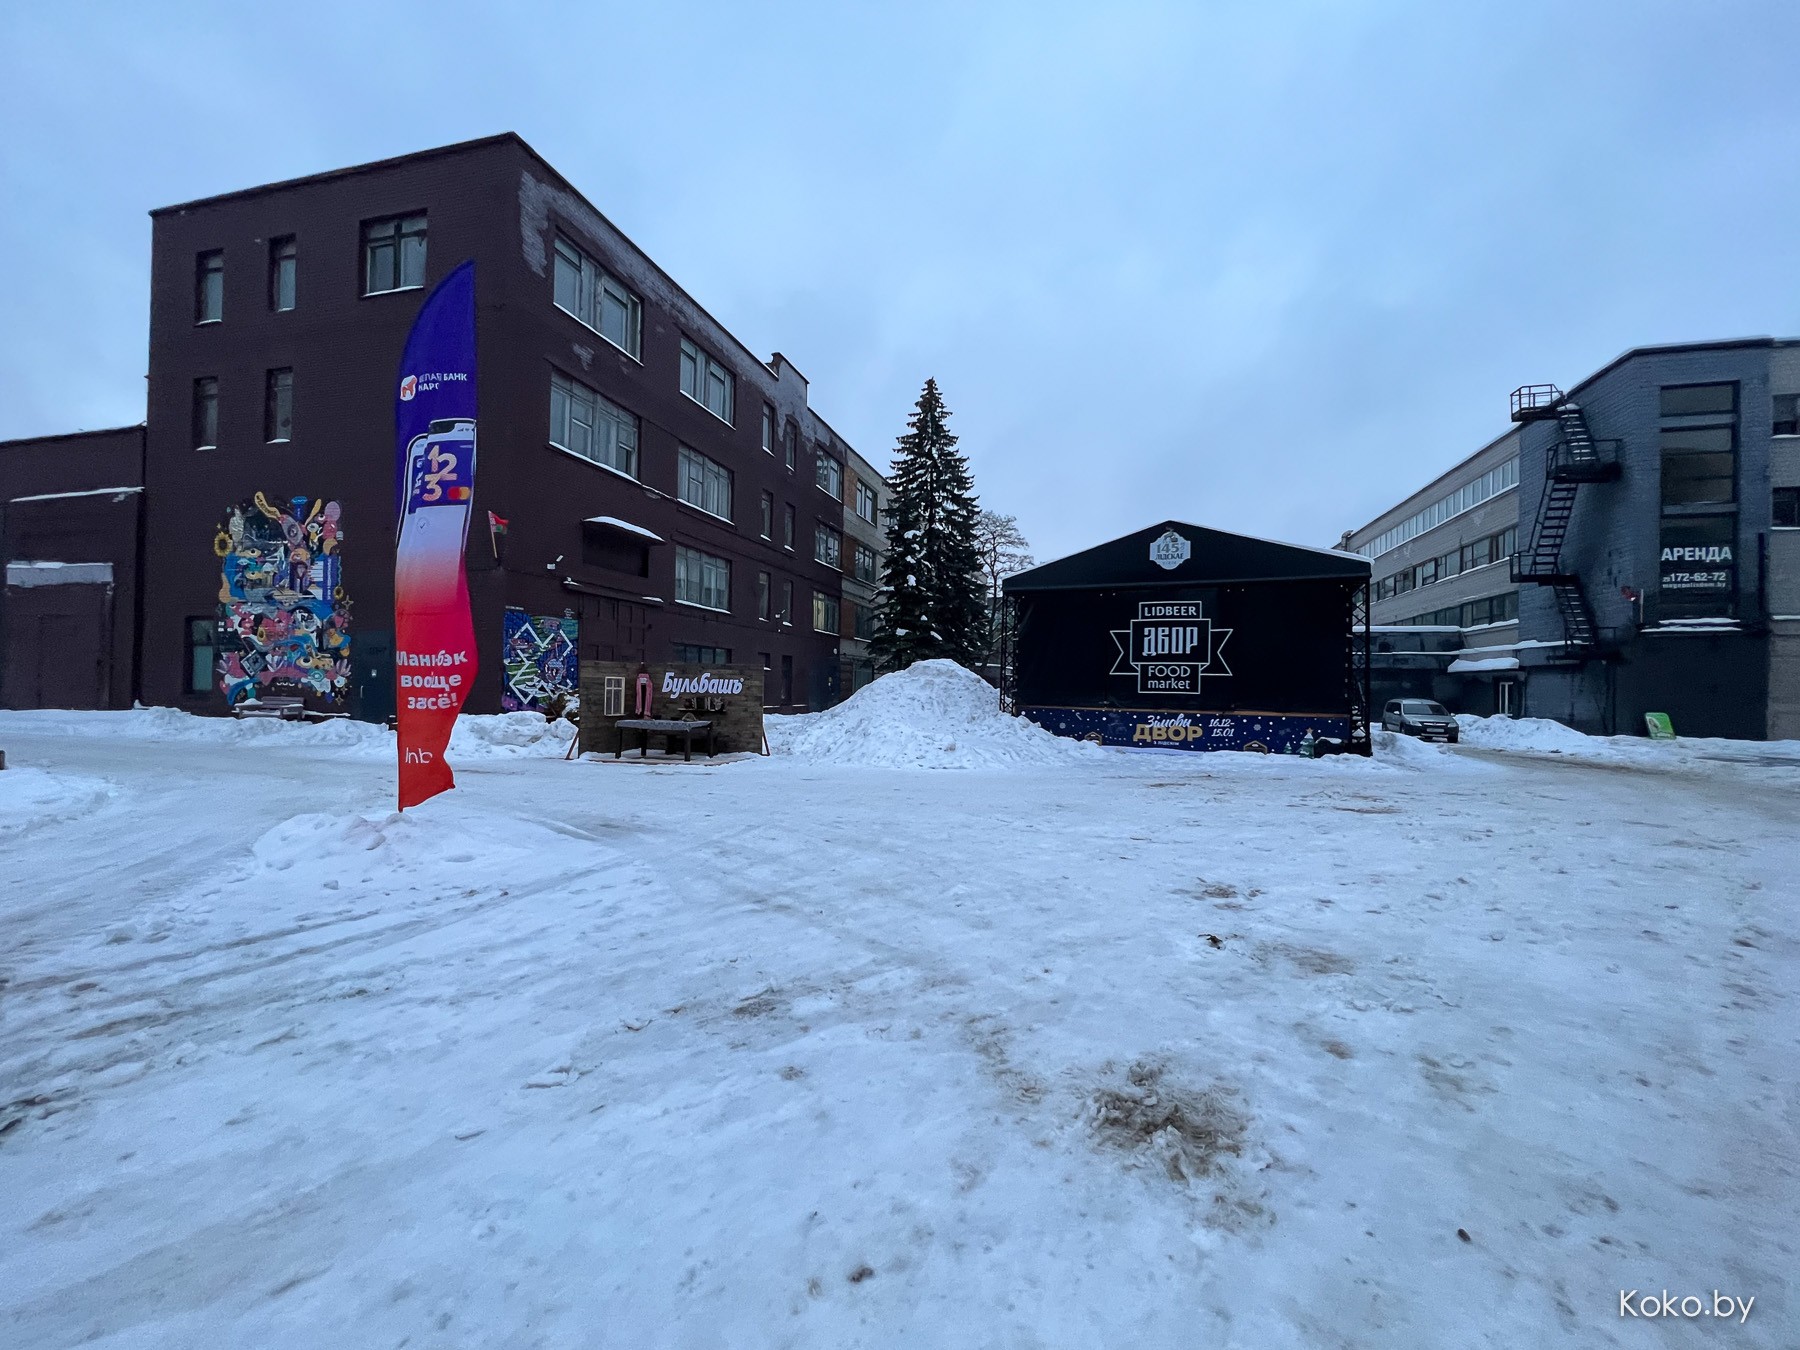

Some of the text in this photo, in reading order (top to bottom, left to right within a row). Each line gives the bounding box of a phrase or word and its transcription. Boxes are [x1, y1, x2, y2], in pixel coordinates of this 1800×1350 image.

[1157, 543, 1180, 553] 145
[1661, 546, 1733, 563] АРЕНДА
[1670, 571, 1727, 582] 172-62-72
[1144, 606, 1197, 617] LIDBEER
[1142, 626, 1198, 657] ДВОР
[1148, 665, 1191, 677] FOOD
[661, 671, 743, 699] Бульбашъ
[1148, 678, 1191, 690] market
[1132, 723, 1203, 742] ДВОР
[1211, 728, 1235, 737] 15.01
